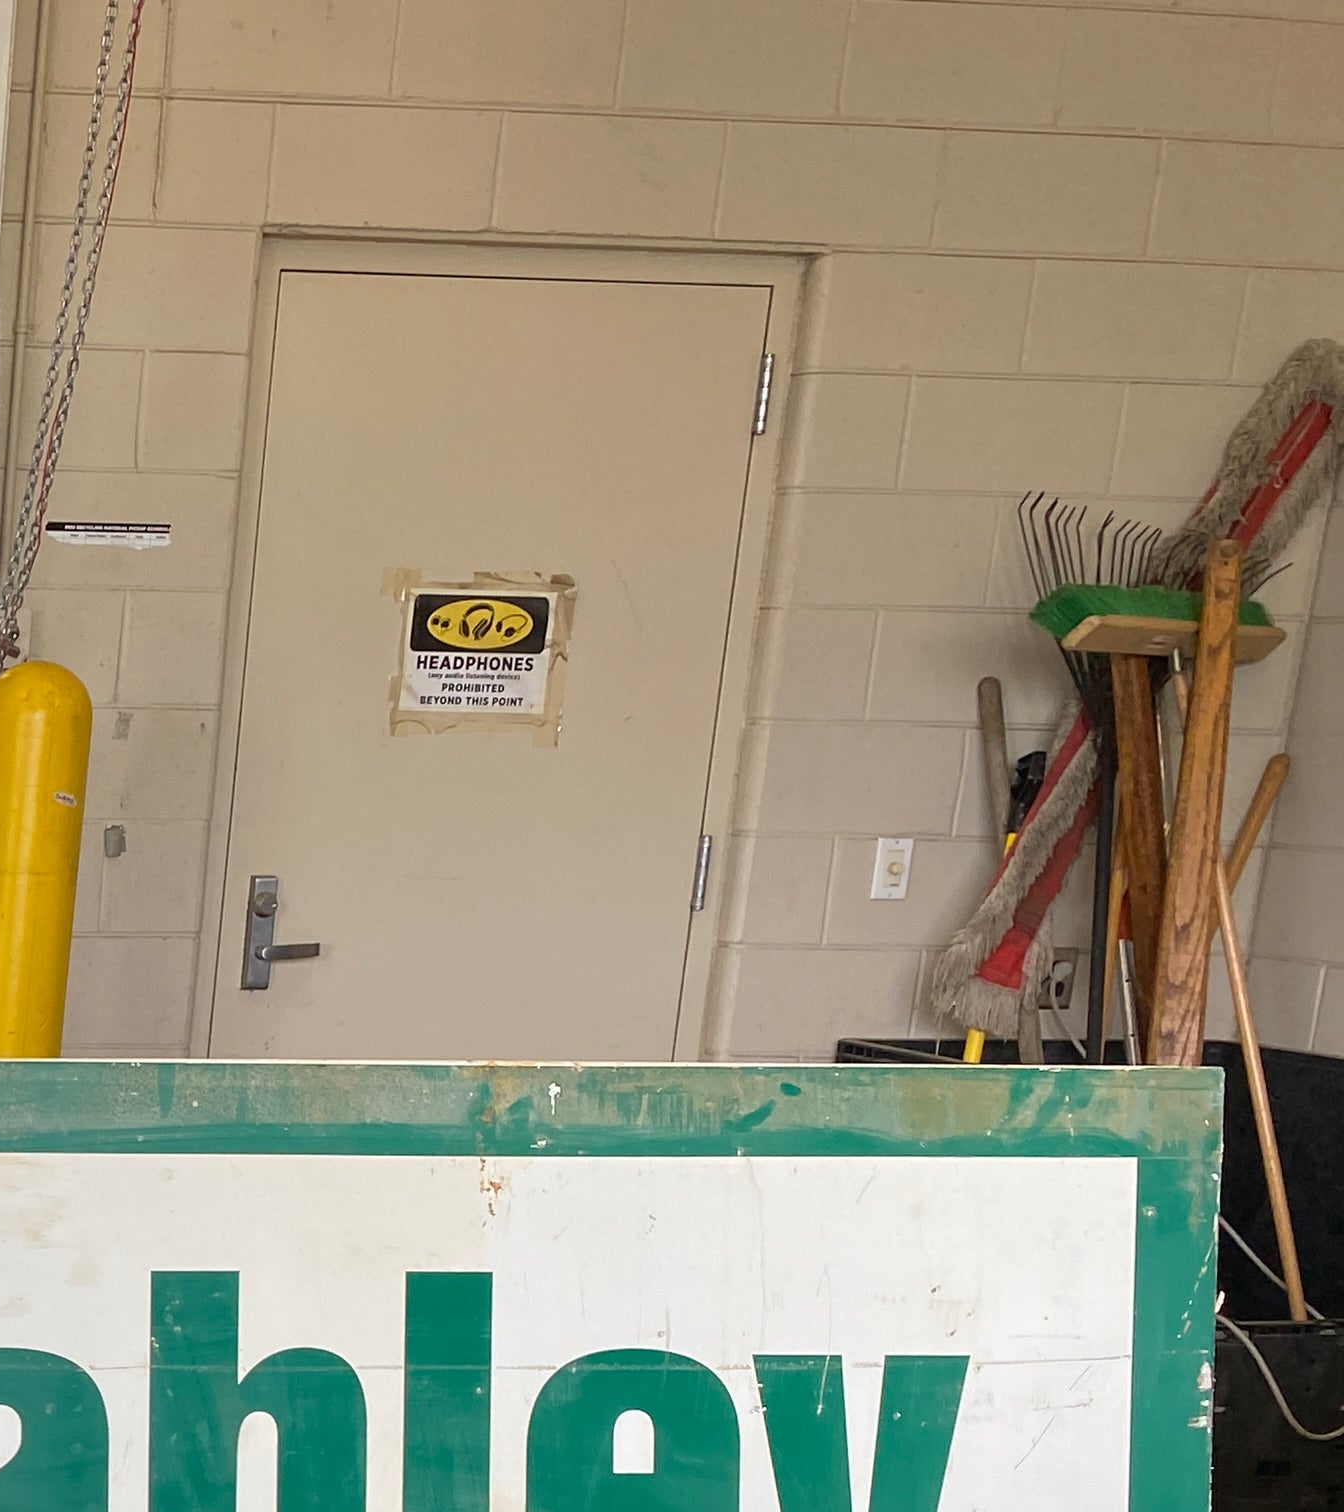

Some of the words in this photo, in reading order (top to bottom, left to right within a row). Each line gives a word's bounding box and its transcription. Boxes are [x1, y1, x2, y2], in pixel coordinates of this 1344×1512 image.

[416, 655, 534, 671] HEADPHONES
[428, 672, 442, 680] (any
[441, 683, 505, 693] PROHIBITED
[420, 695, 462, 705] BEYOND
[466, 696, 489, 706] THIS
[492, 697, 524, 707] POINT
